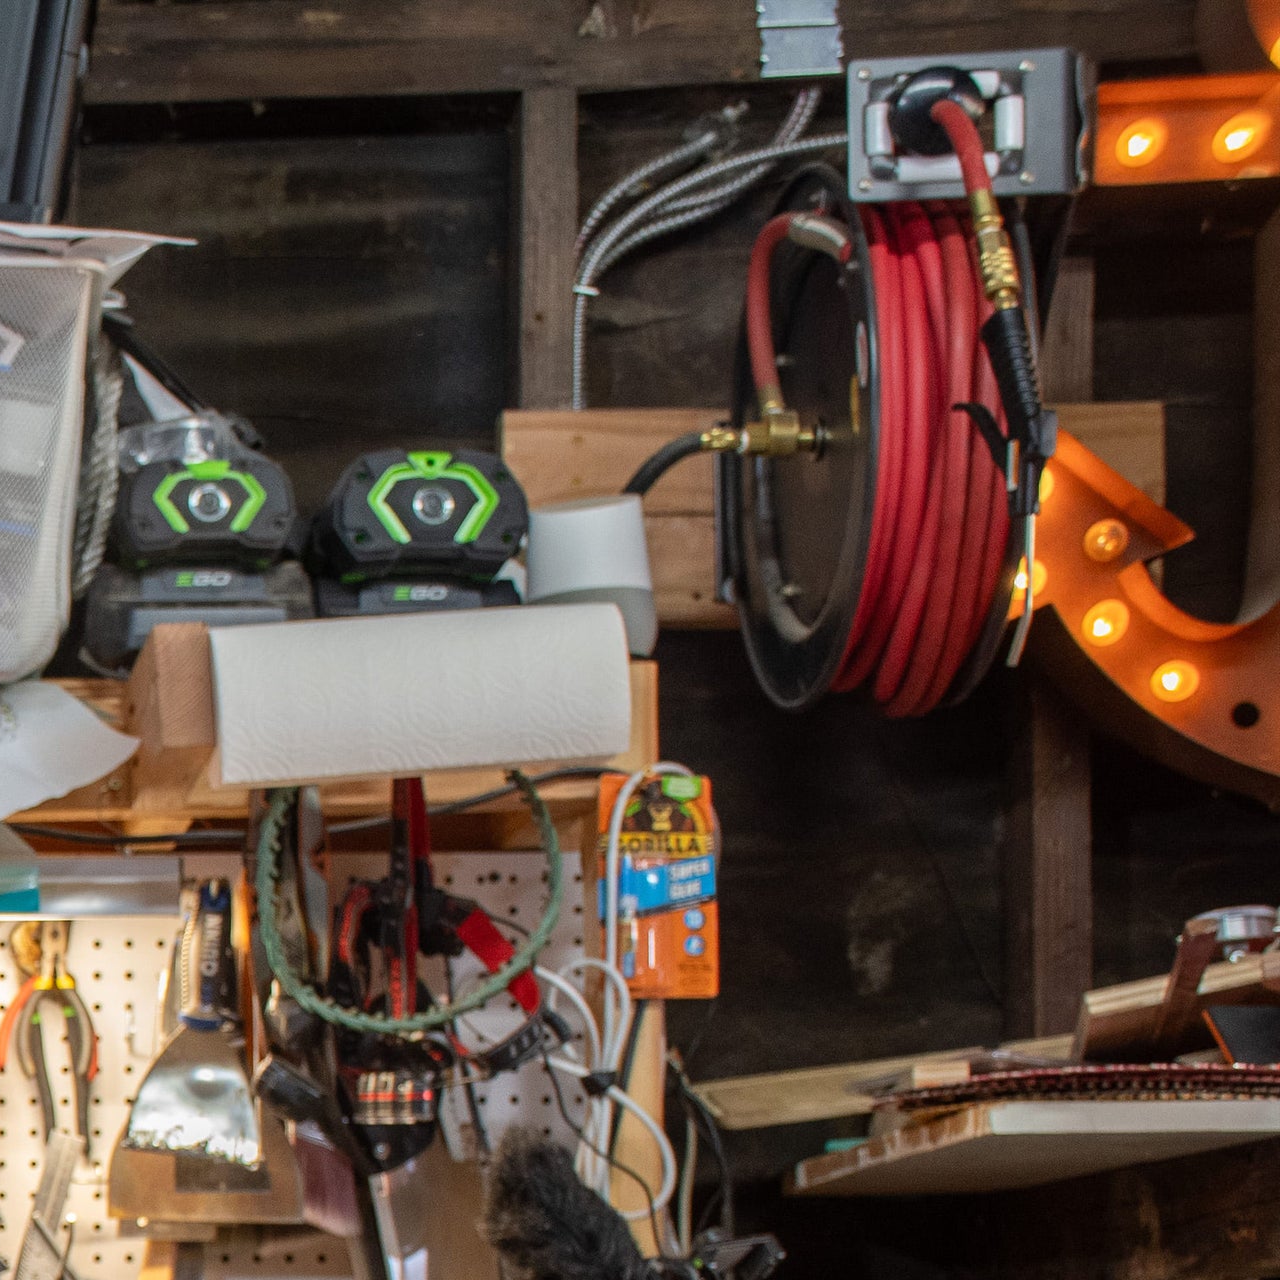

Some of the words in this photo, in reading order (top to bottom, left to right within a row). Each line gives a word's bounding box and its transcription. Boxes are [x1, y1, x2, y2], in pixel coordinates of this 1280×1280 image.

[176, 572, 232, 588] EGO
[394, 586, 448, 601] EGO
[670, 860, 711, 882] SUPER
